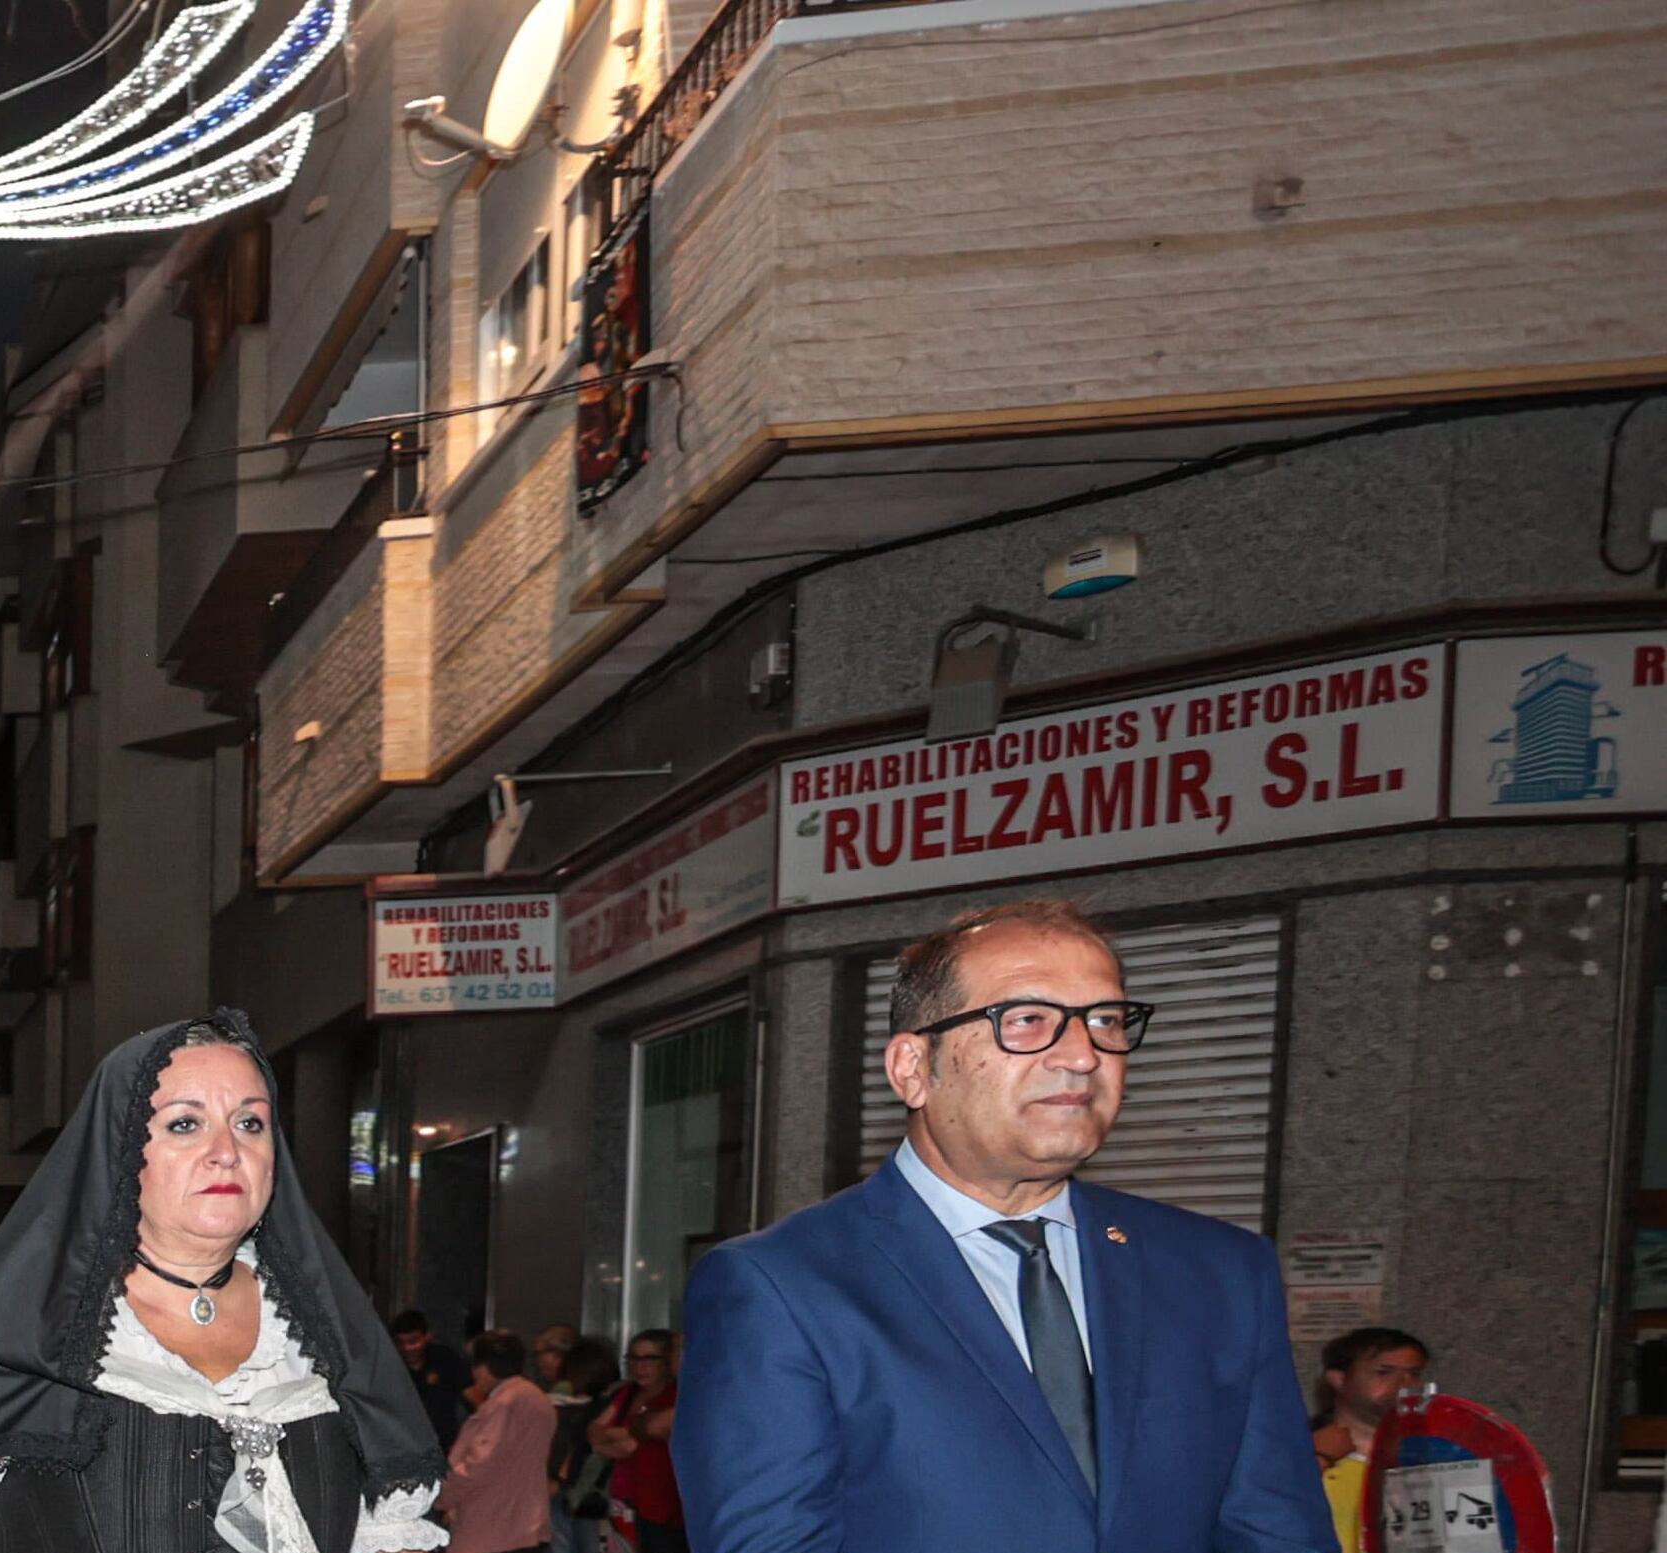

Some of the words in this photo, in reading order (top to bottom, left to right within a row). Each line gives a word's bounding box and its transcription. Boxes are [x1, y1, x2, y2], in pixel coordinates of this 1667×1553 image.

[790, 710, 1139, 805] REHABILITACIONES
[1151, 703, 1175, 742] Y
[1186, 657, 1430, 738] REFORMAS
[823, 749, 1234, 874] RUELZAMIR,
[1261, 722, 1405, 809] S.L.
[383, 900, 550, 925] REHABILITACIONES
[412, 927, 421, 945] Y
[427, 922, 521, 944] REFORMAS
[387, 948, 510, 980] RUELZAMIR,
[516, 946, 553, 974] S.L.
[419, 984, 457, 1003] 637
[463, 983, 492, 1001] 42
[496, 982, 524, 1000] 52
[527, 981, 555, 999] 01
